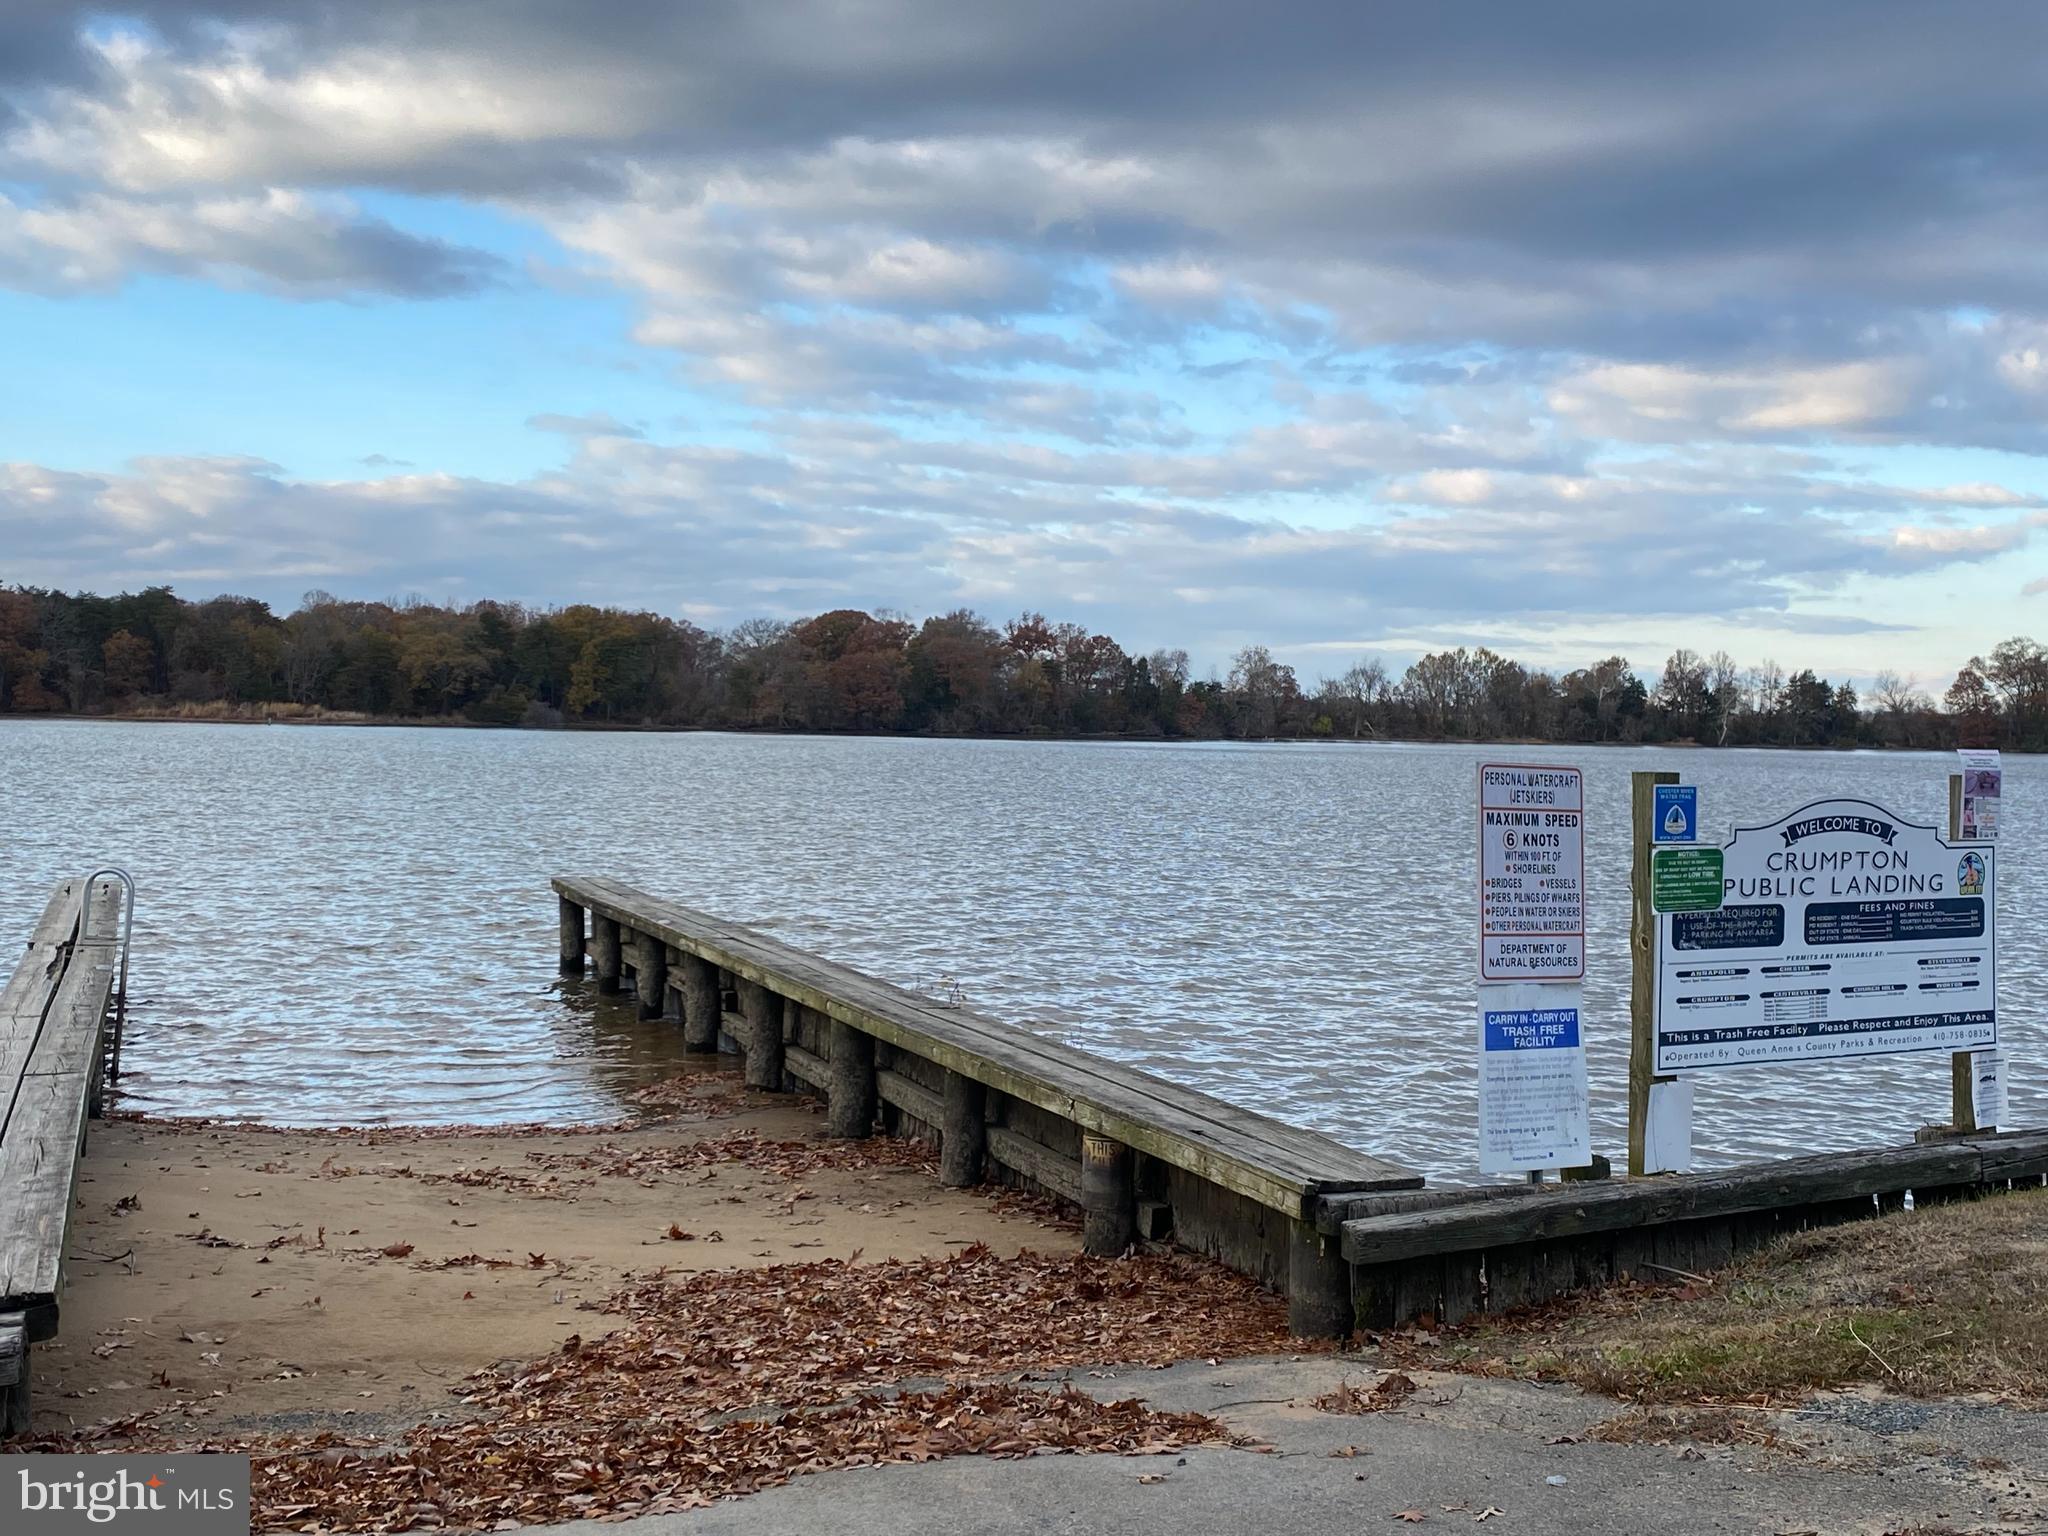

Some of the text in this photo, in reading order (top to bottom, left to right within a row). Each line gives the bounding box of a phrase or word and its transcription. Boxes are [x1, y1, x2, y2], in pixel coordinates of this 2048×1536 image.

[1485, 772, 1578, 788] PERSONAL WATERCRAFT
[1510, 789, 1555, 805] (JETSKIERS)
[1486, 812, 1578, 827] MAXIMUM SPEED
[1796, 818, 1882, 836] WELCOME TO
[1506, 833, 1559, 847] 6 KNOTS
[1505, 851, 1528, 861] WITHIN
[1531, 852, 1540, 861] 100
[1553, 852, 1561, 861] OF
[1767, 851, 1908, 872] CRUMPTON
[1513, 864, 1556, 874] SHORELINES
[1491, 878, 1522, 888] BRIDGES
[1546, 879, 1576, 888] VESSELS
[1724, 874, 1943, 897] PUBLIC LANDING
[1514, 893, 1539, 902] PILINGS
[1552, 893, 1580, 903] WHARFS
[1491, 907, 1580, 917] PEOPLE IN WATER OR SKIERS
[1860, 902, 1935, 912] FEES AND FINES
[1722, 908, 1760, 918] REQUIRED
[1762, 908, 1778, 916] FOR
[1491, 921, 1580, 931] OTHER PERSONAL WATERCRAFT
[1501, 944, 1567, 954] DEPARTMENT OF
[1489, 957, 1578, 967] NATURAL RESOURCES
[1489, 1015, 1518, 1025] CARRY
[1520, 1014, 1528, 1023] IN
[1532, 1013, 1558, 1023] CARRY
[1560, 1012, 1575, 1022] OUT
[1502, 1025, 1565, 1037] TRASH FREE
[1666, 1032, 1688, 1042] This
[1692, 1032, 1700, 1040] is
[1714, 1029, 1742, 1039] Trash
[1746, 1028, 1770, 1037] Free
[1773, 1023, 1808, 1036] Facility
[1819, 1023, 1850, 1032] Please
[1853, 1020, 1891, 1031] Respect
[1894, 1018, 1911, 1027] and
[1914, 1016, 1938, 1026] Enjoy
[1942, 1014, 1960, 1023] This
[1965, 1013, 1989, 1022] Area.
[1514, 1037, 1556, 1047] FACILITY
[1670, 1050, 1714, 1062] Operated
[1738, 1047, 1767, 1057] Queen
[1806, 1042, 1836, 1051] County
[1841, 1040, 1864, 1048] Parks
[1868, 1038, 1874, 1046] &
[1878, 1035, 1922, 1045] Recreation
[1091, 1141, 1115, 1156] THIS
